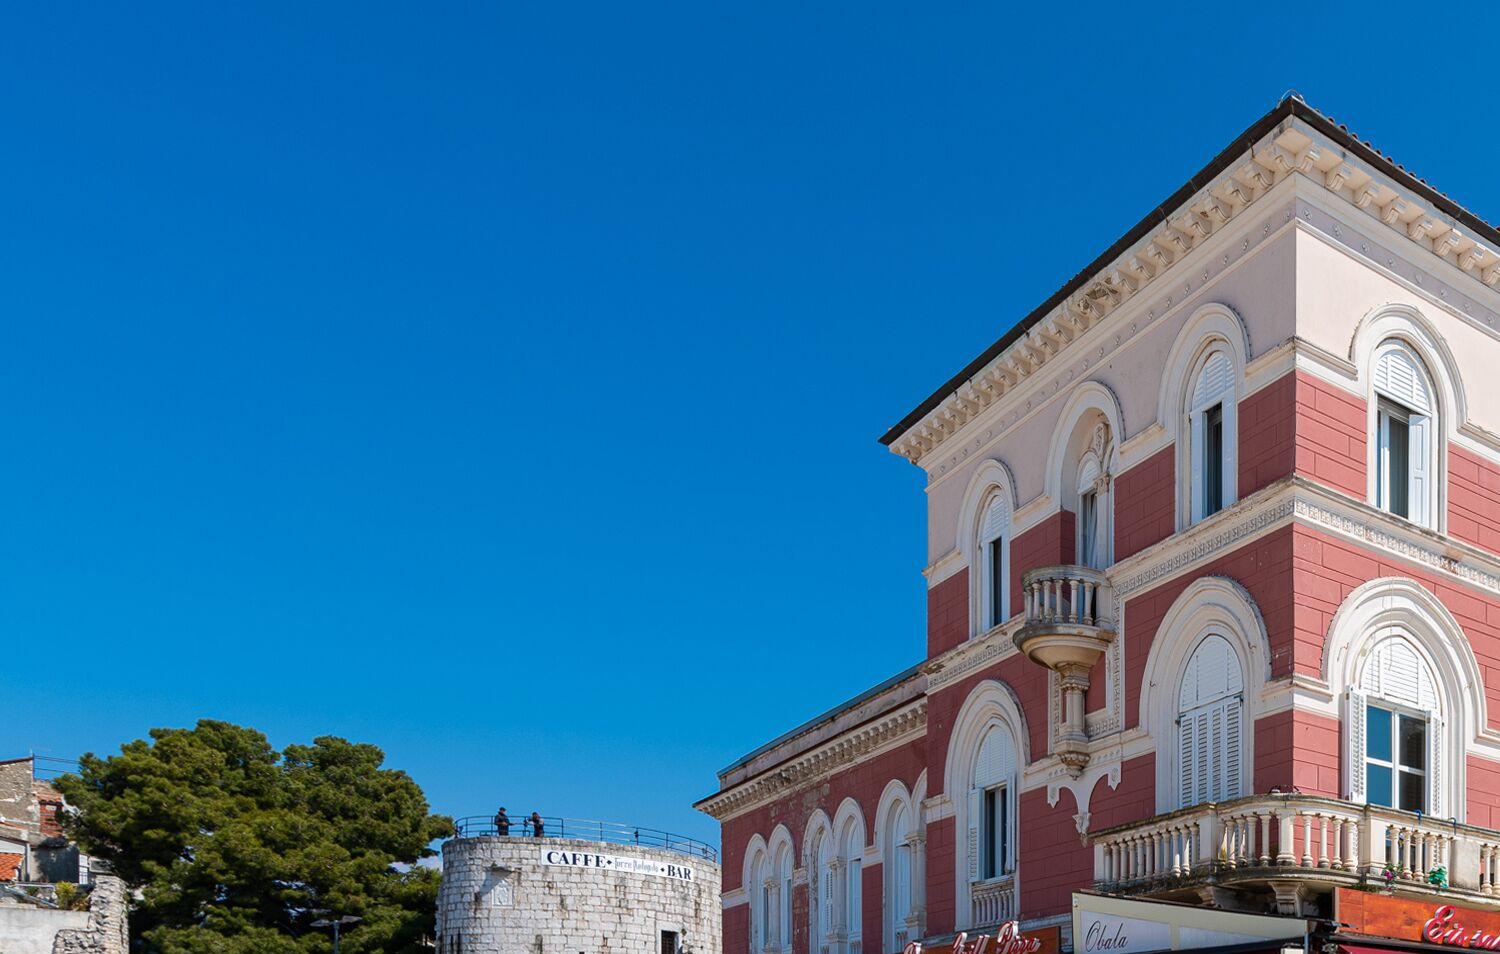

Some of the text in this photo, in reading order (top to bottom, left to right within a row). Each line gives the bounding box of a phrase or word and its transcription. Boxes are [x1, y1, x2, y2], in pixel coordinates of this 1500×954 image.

[547, 851, 606, 868] CAFFE
[667, 865, 692, 880] BAR
[1086, 920, 1128, 952] Obala
